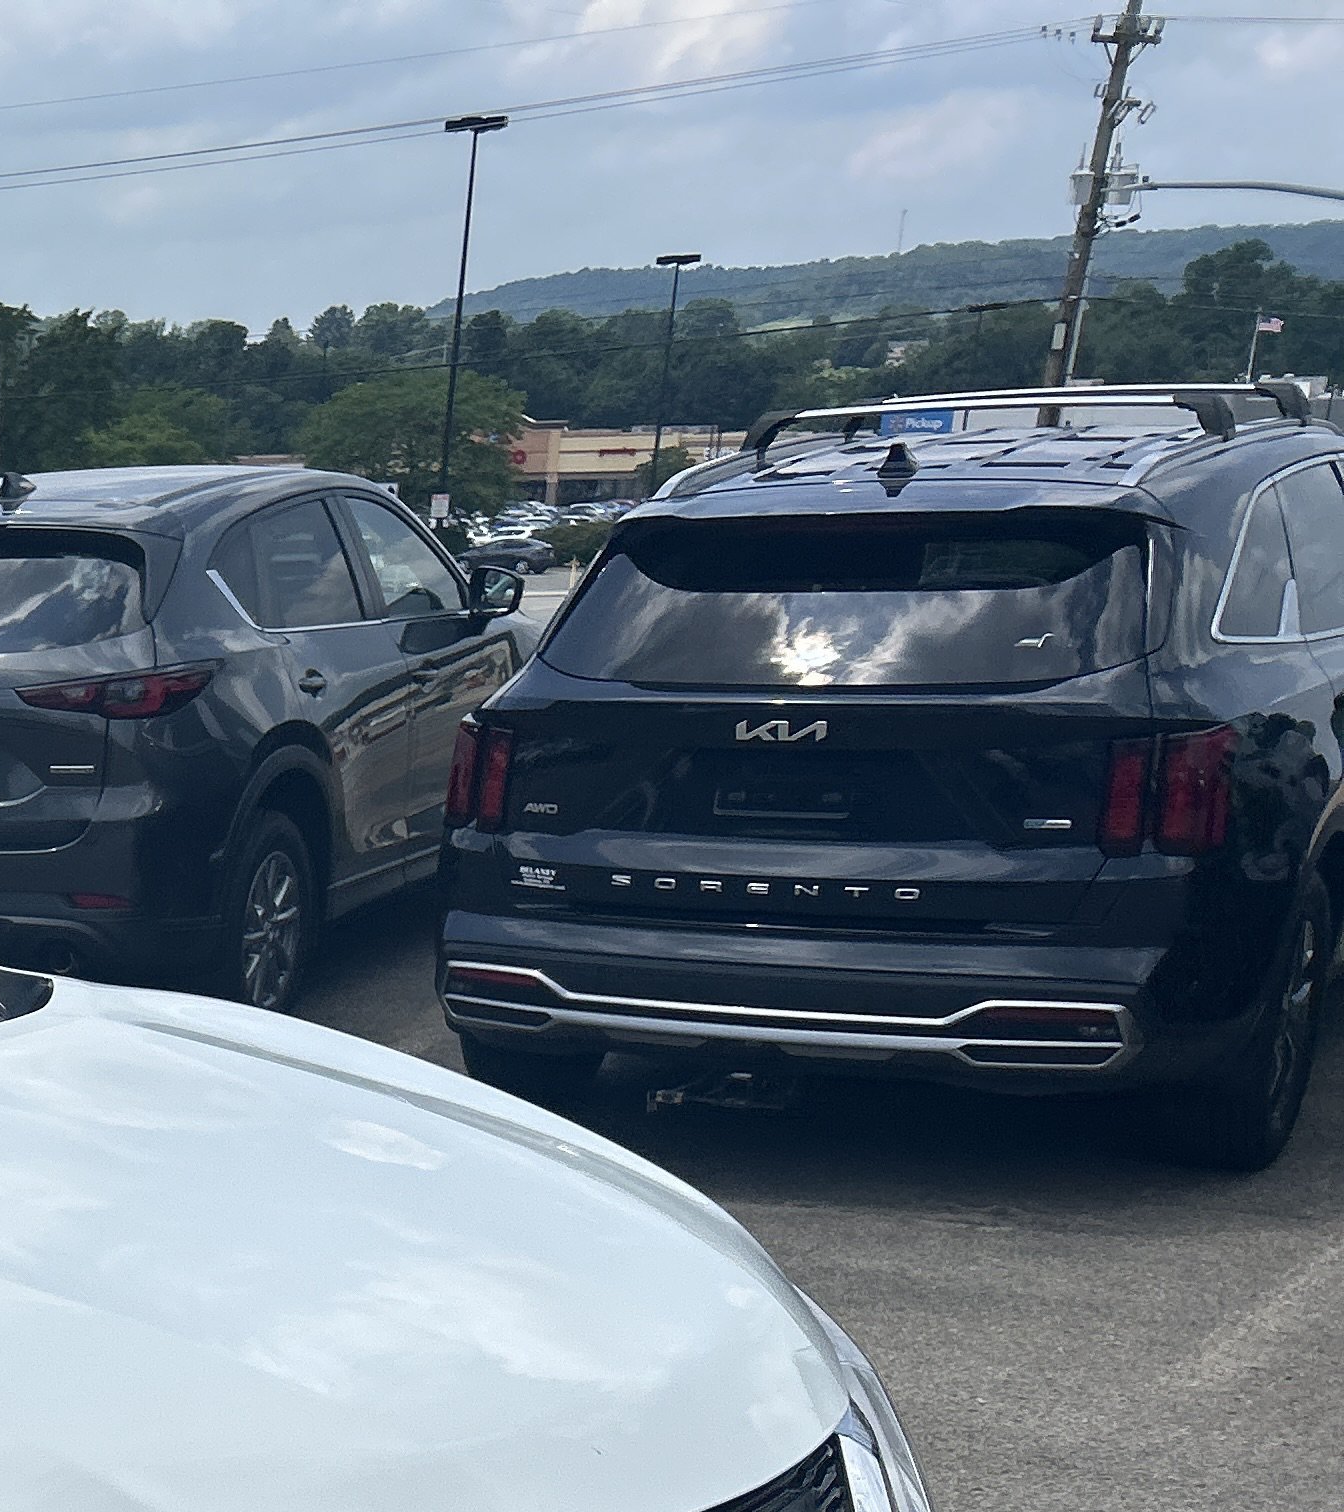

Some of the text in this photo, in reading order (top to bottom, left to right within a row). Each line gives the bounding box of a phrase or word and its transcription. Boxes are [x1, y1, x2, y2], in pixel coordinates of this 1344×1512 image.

[905, 417, 943, 431] Pickup
[523, 802, 558, 815] AWD
[610, 874, 921, 900] SORENTO
